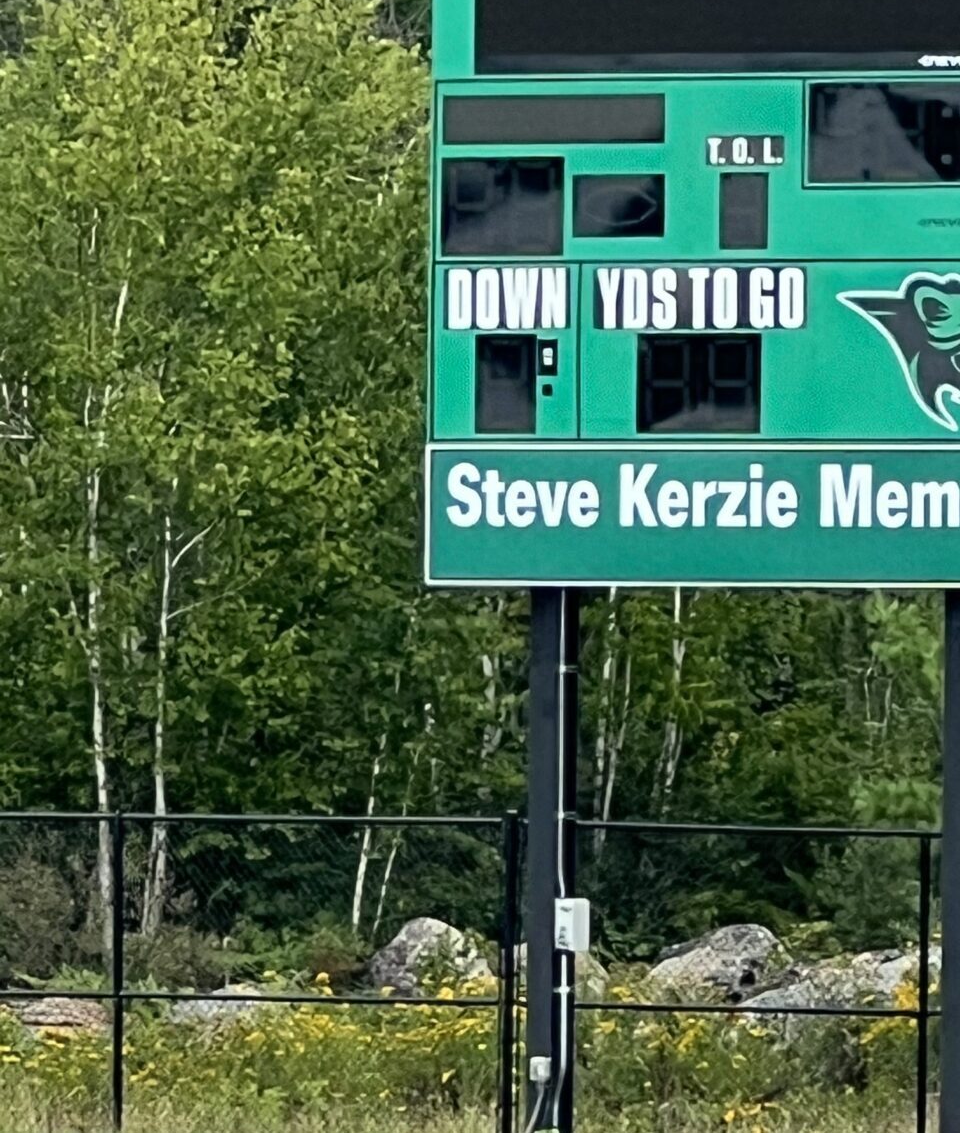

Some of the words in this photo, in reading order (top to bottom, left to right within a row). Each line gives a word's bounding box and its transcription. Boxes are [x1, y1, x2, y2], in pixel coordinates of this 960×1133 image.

[448, 268, 567, 329] DOWN
[598, 268, 677, 329] YDS
[688, 268, 738, 329] TO
[749, 268, 805, 329] GO
[446, 462, 600, 528] Steve
[619, 463, 798, 528] Kerzie
